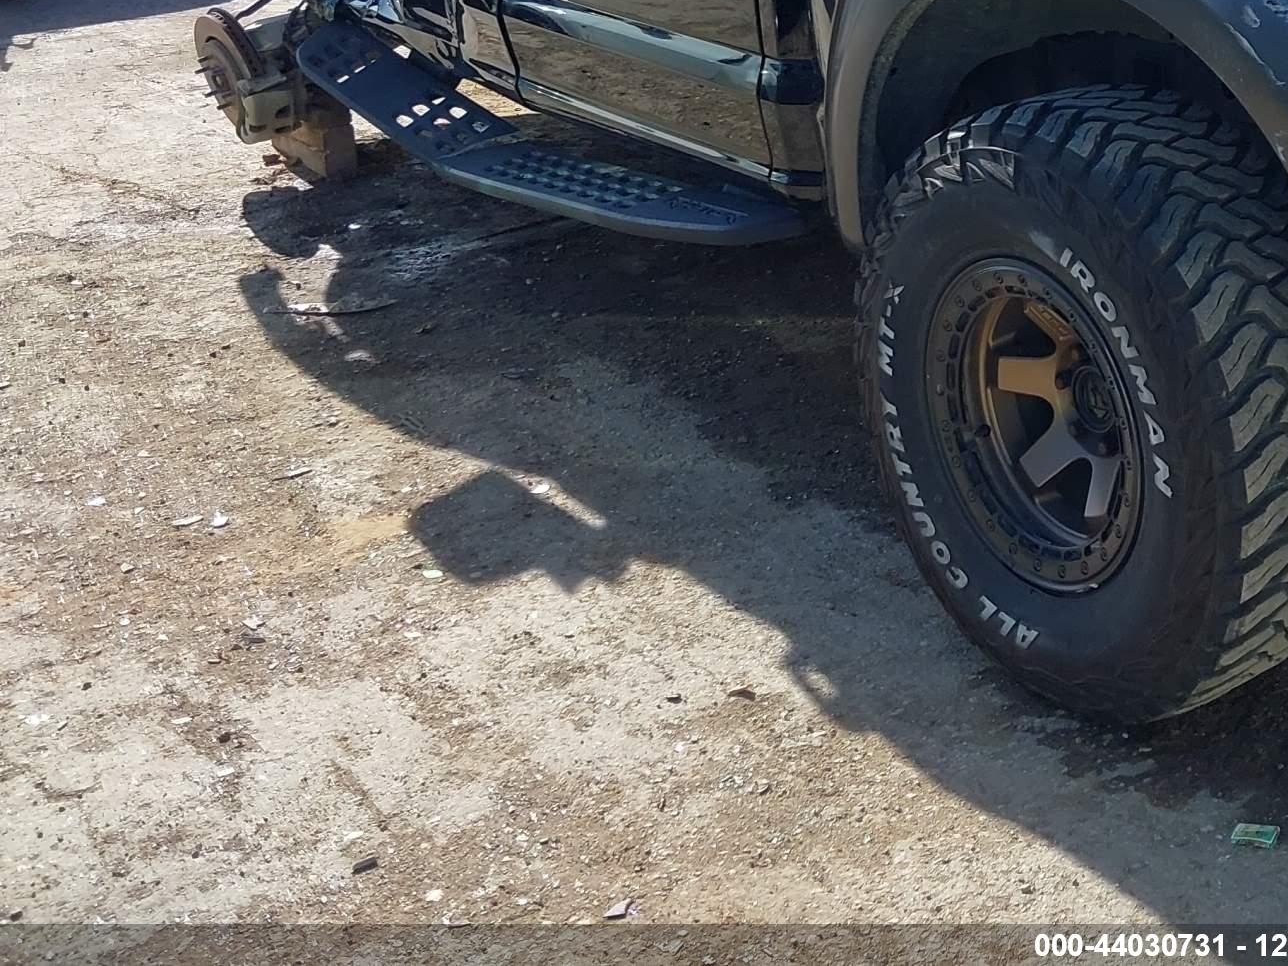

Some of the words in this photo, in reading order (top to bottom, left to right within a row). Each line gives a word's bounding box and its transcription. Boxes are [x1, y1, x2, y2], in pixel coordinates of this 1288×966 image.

[878, 280, 905, 377] MT-X
[1059, 247, 1173, 499] IRONMAN
[879, 388, 969, 590] COUNTRY
[978, 594, 1040, 650] ALL
